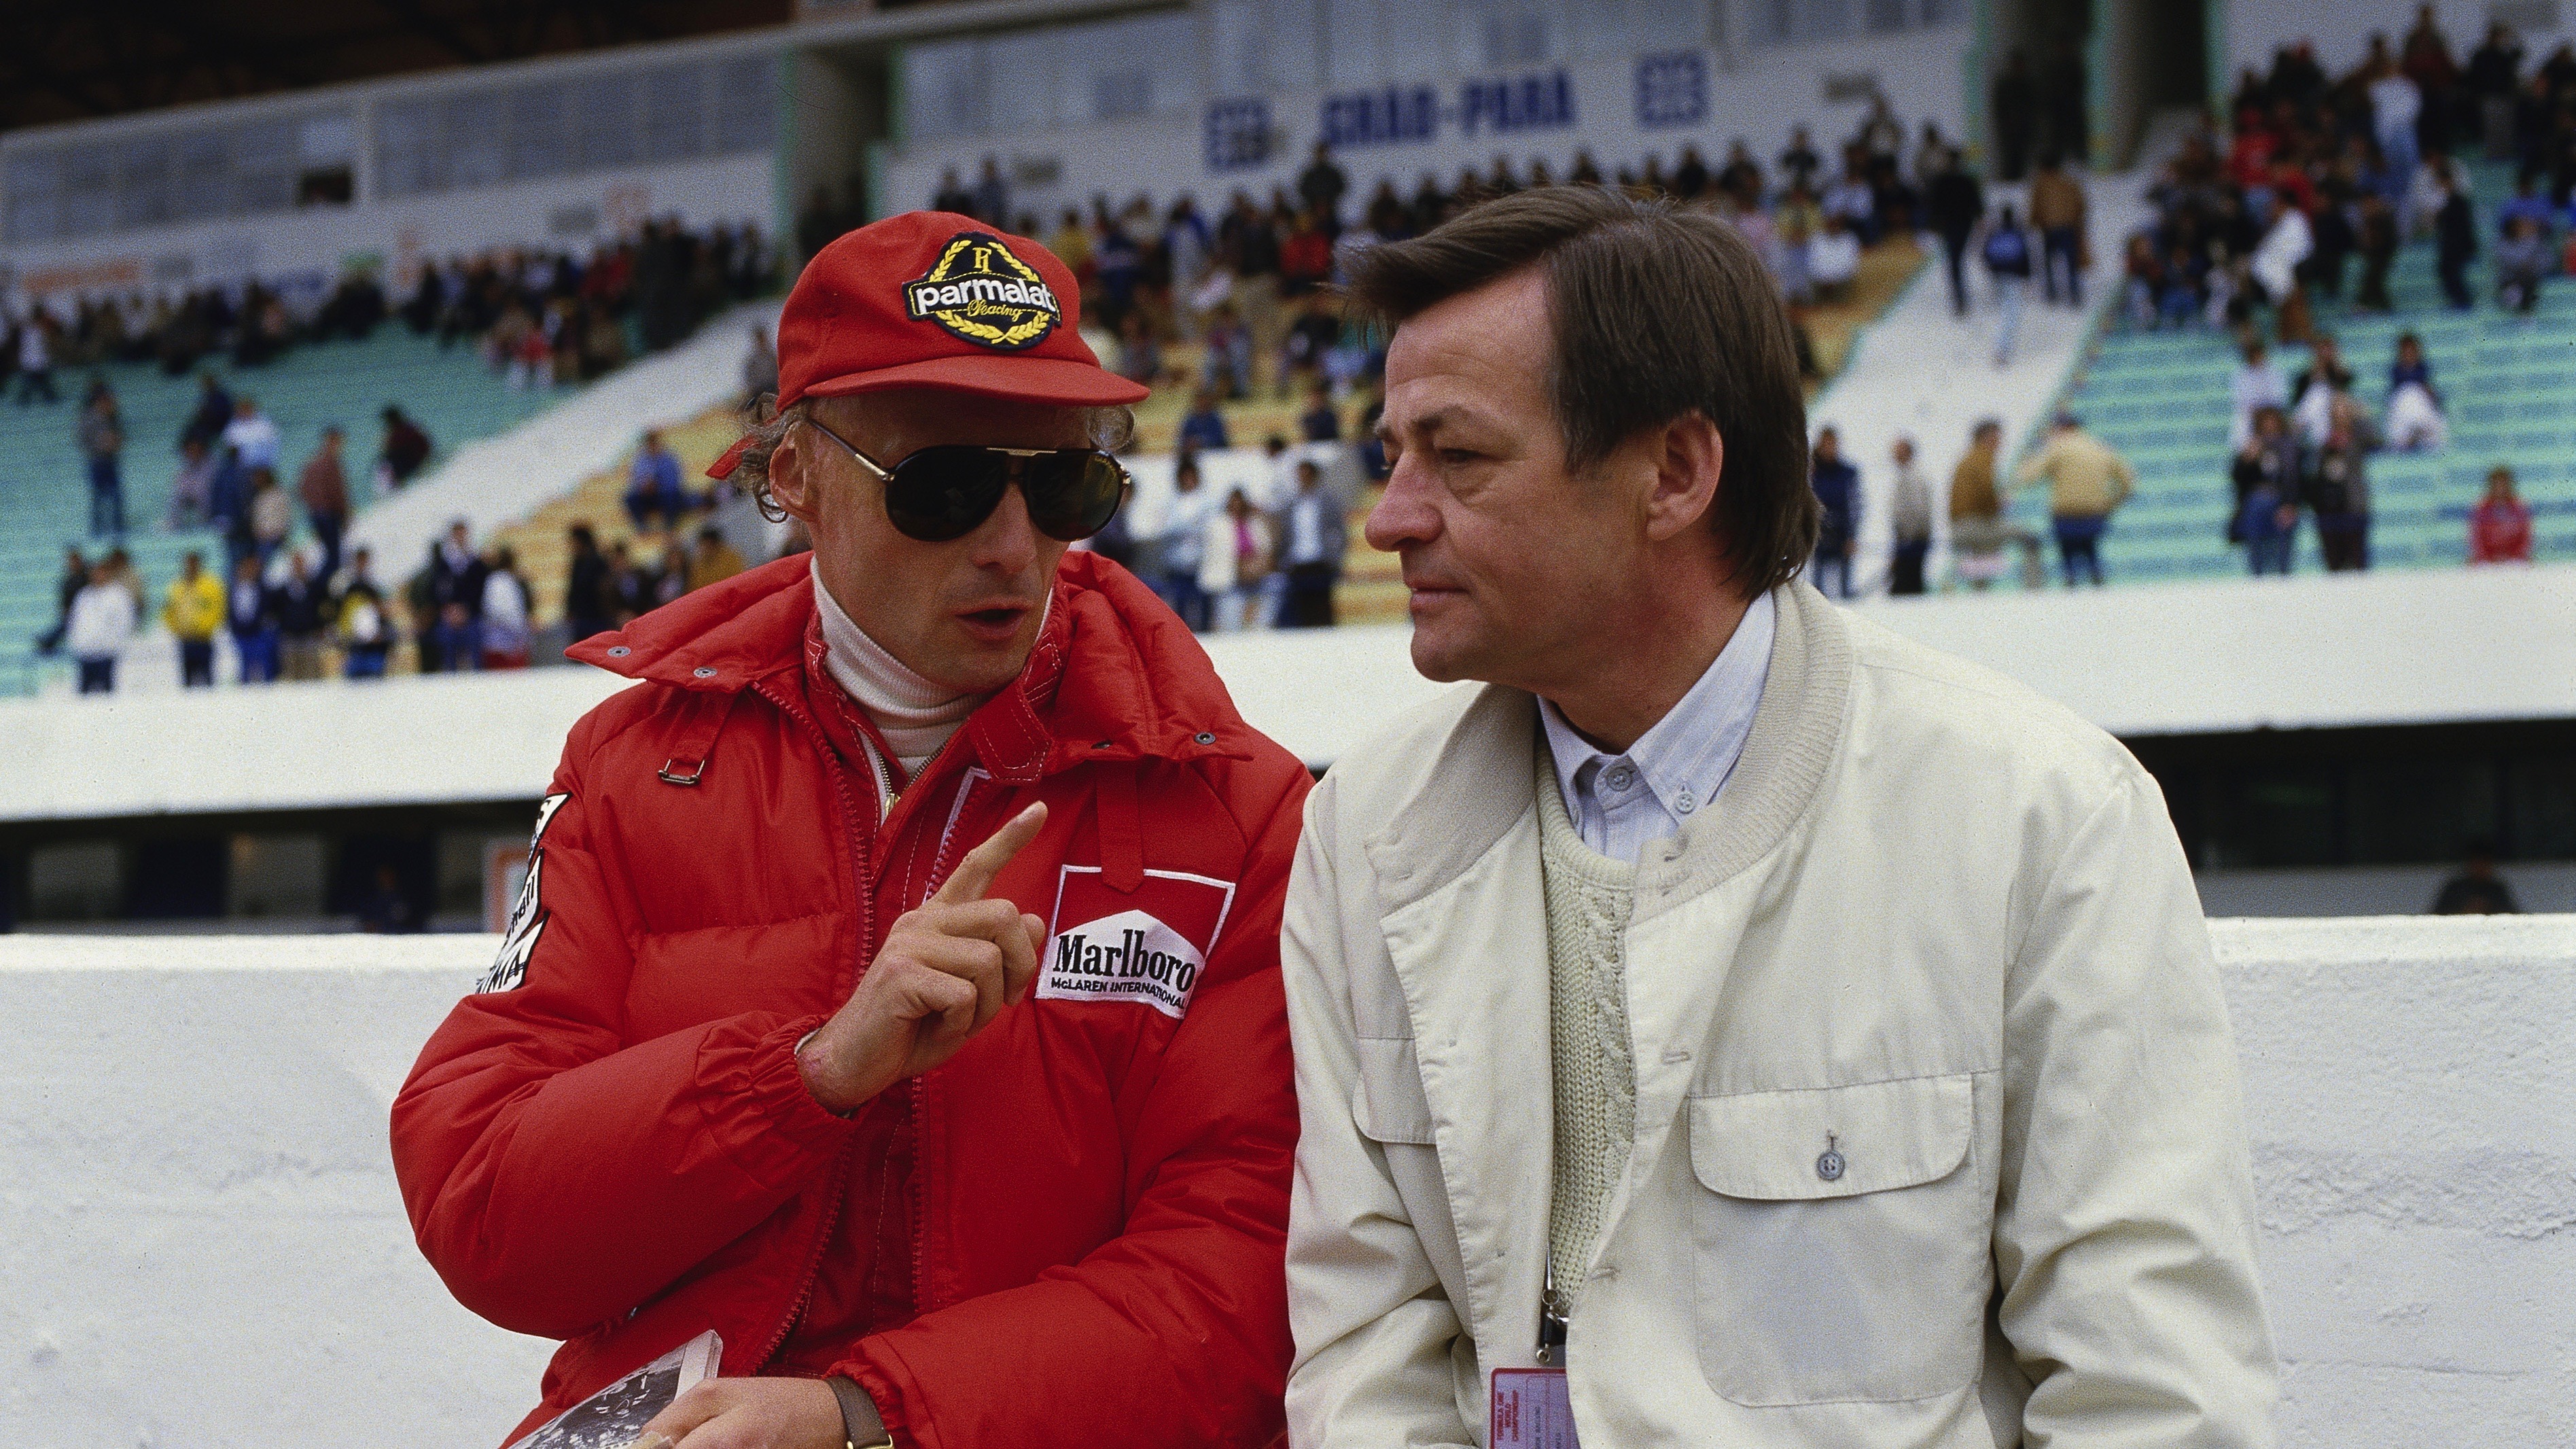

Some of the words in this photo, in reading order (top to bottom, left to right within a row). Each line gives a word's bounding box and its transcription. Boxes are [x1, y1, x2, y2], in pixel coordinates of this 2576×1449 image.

[916, 279, 1056, 314] parmalat
[1053, 929, 1195, 992] Marlboro
[1051, 977, 1108, 992] McLAREN
[1110, 982, 1186, 1009] INTERNATIONAL
